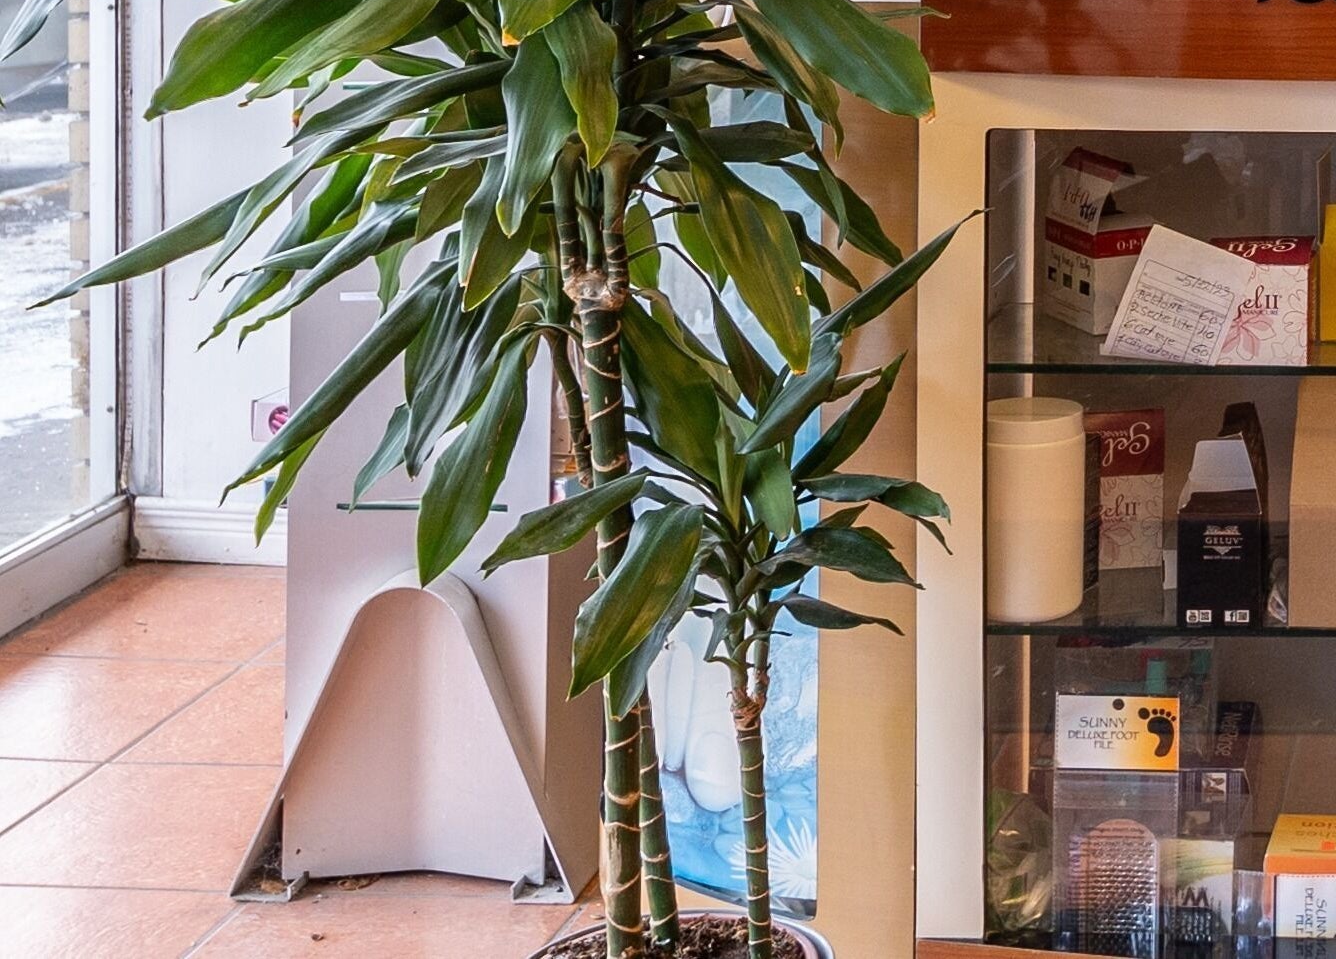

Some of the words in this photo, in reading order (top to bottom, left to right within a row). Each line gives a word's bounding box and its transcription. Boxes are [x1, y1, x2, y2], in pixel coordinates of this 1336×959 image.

[1079, 715, 1128, 729] SUNNY
[1068, 730, 1109, 740] DELUXE
[1110, 730, 1140, 741] FOOT
[1094, 740, 1115, 750] FILE
